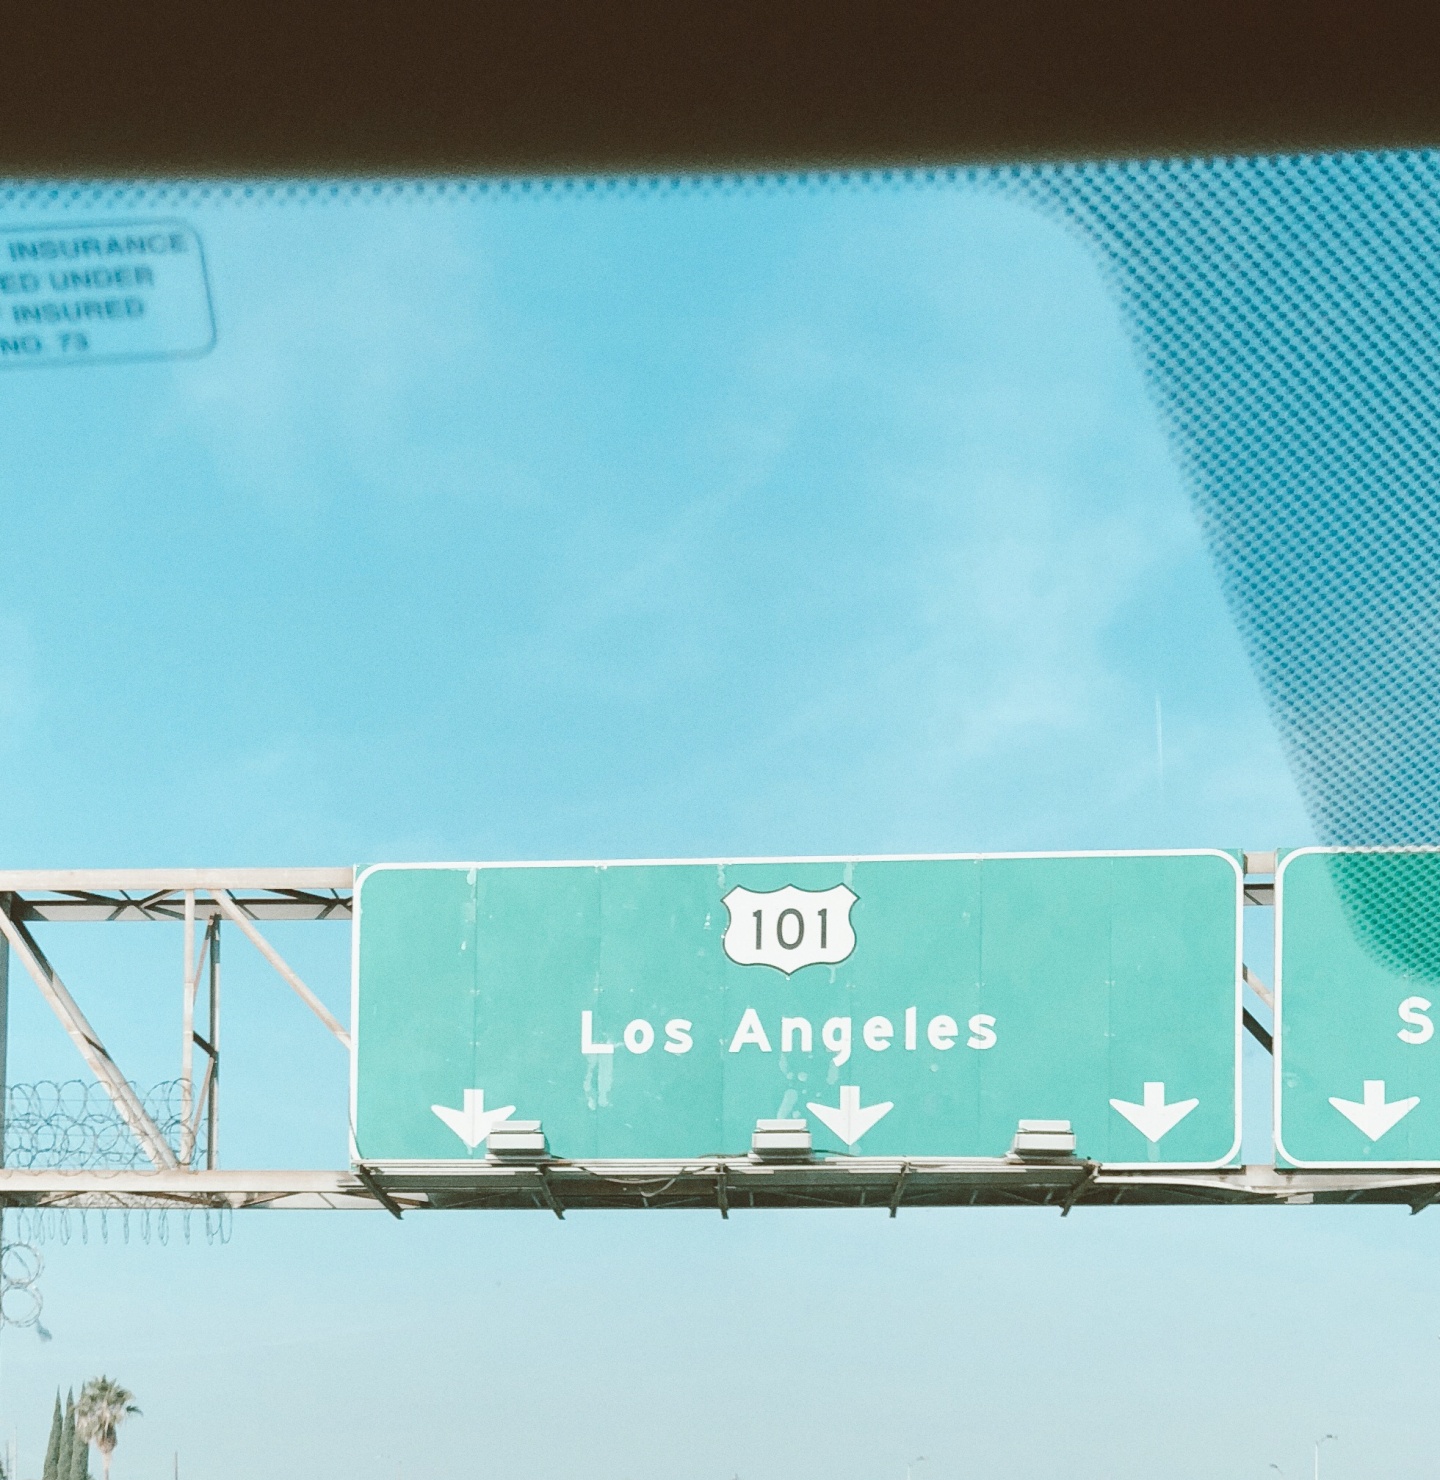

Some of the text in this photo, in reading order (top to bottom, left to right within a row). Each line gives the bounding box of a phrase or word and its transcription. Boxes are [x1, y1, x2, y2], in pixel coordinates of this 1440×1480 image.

[8, 233, 184, 262] INSURANCE
[49, 265, 154, 291] UNDER
[12, 298, 144, 324] INSURED
[753, 908, 827, 950] 101
[581, 1006, 998, 1067] Los Angeles
[1397, 996, 1434, 1045] S
